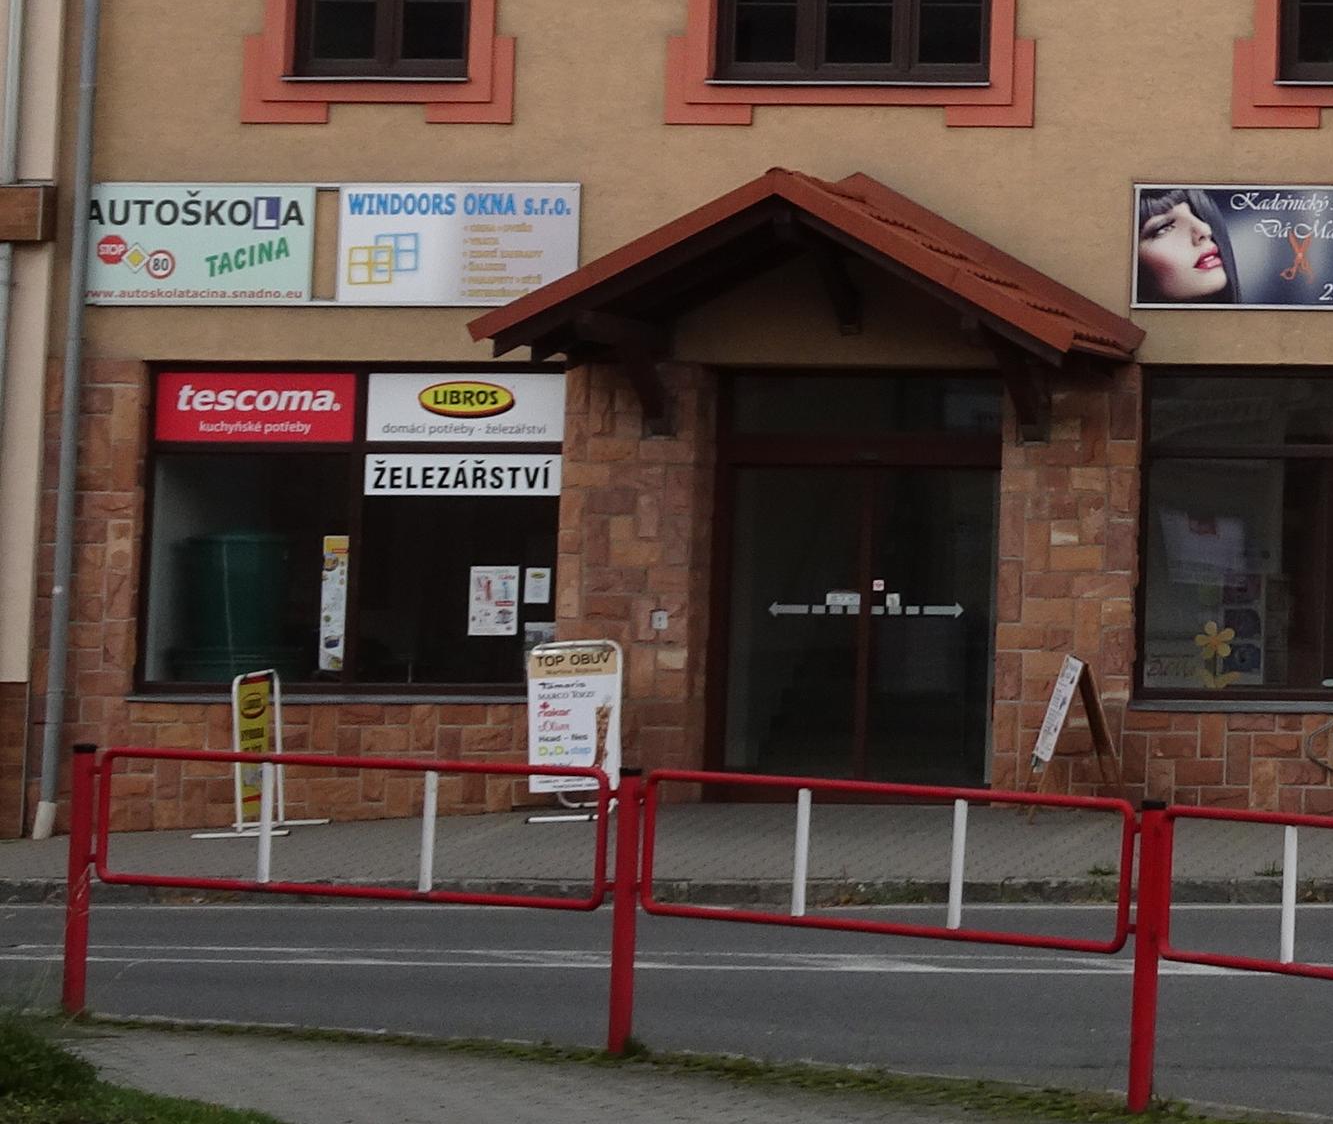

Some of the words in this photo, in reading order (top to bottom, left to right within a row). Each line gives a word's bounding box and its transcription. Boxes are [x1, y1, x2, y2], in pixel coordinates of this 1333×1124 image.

[88, 190, 304, 226] AUTOŠKOLA
[348, 193, 456, 215] WINDOORS
[463, 193, 517, 215] OKNA
[524, 197, 571, 216] s.r.o.
[1230, 192, 1328, 216] Kadeřnický
[152, 257, 169, 271] 80
[205, 237, 290, 277] TACINA
[178, 384, 341, 411] tescoma.
[433, 390, 499, 406] LIBROS
[199, 420, 262, 435] kuchyňské
[264, 420, 311, 435] potřeby
[382, 422, 427, 435] domácí
[428, 422, 475, 437] potřeby
[485, 422, 546, 435] železářství
[373, 459, 552, 490] ŽELEZÁŘSTVÍ
[537, 655, 565, 667] TOP
[570, 652, 610, 666] OBUV
